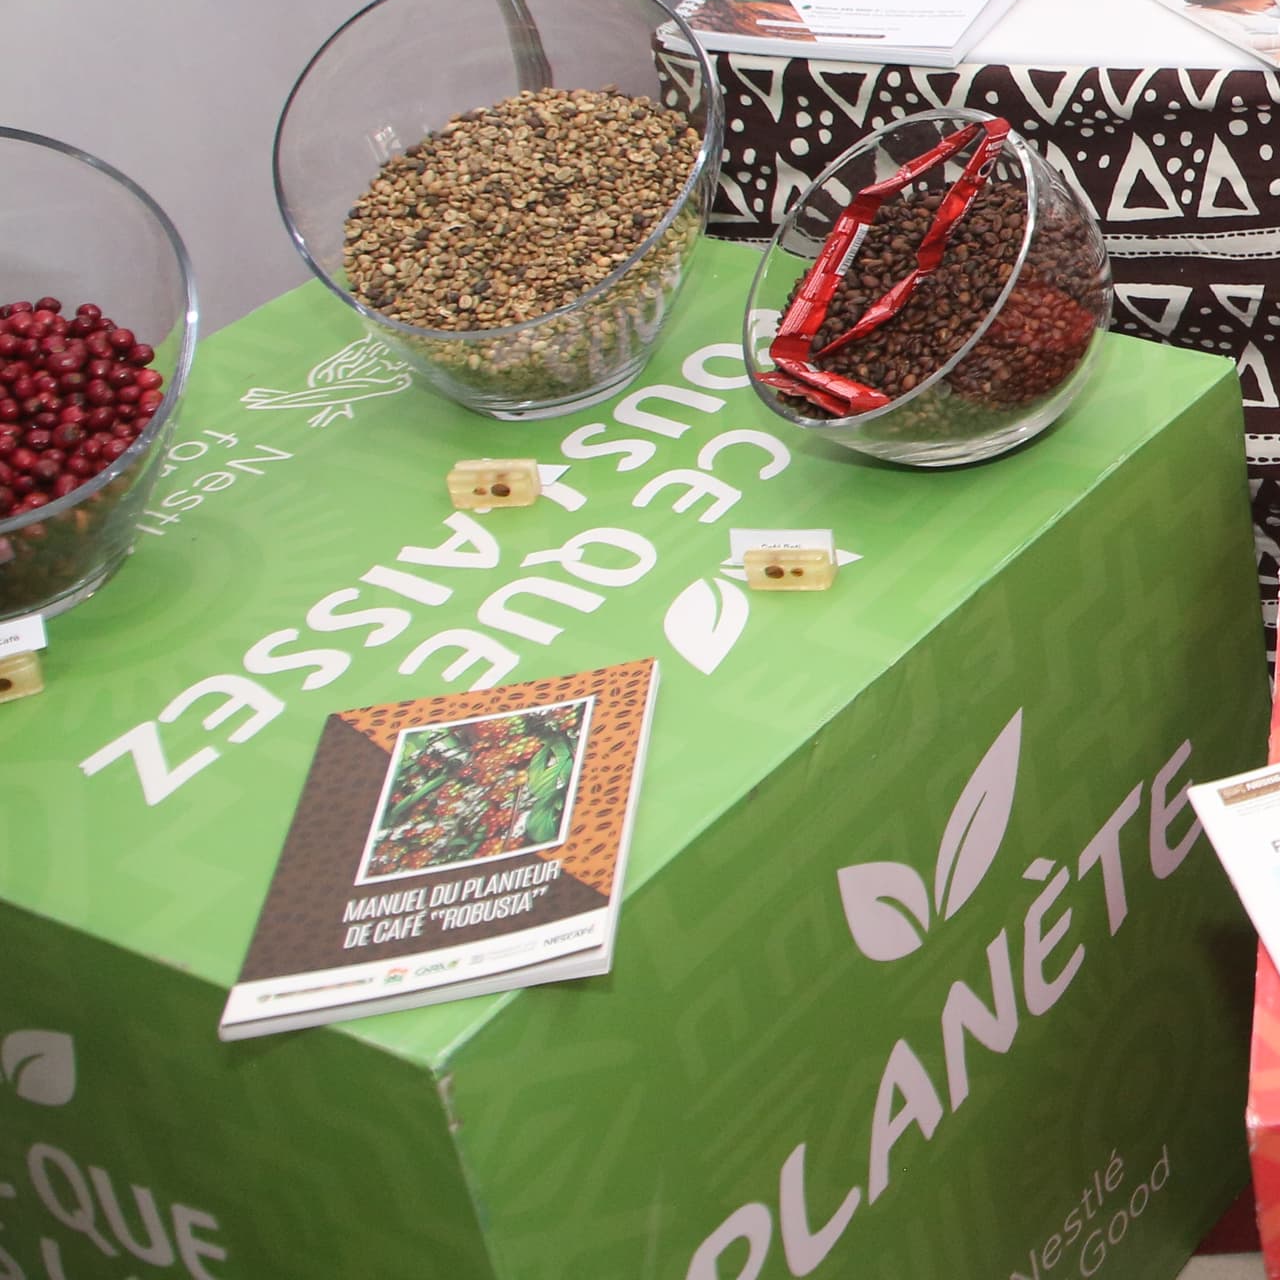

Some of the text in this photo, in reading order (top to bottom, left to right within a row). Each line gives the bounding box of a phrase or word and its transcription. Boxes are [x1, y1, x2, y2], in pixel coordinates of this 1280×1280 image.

[134, 443, 295, 536] Nestl
[397, 429, 791, 694] CE QUE
[79, 458, 588, 806] AISSEZ
[342, 859, 562, 924] MANUEL DU PLANTEUR
[342, 923, 375, 950] DE
[372, 910, 428, 947] CAFÉ
[685, 738, 1205, 1280] PLANÈTE
[27, 1142, 229, 1280] QUE
[1078, 1143, 1171, 1279] Good
